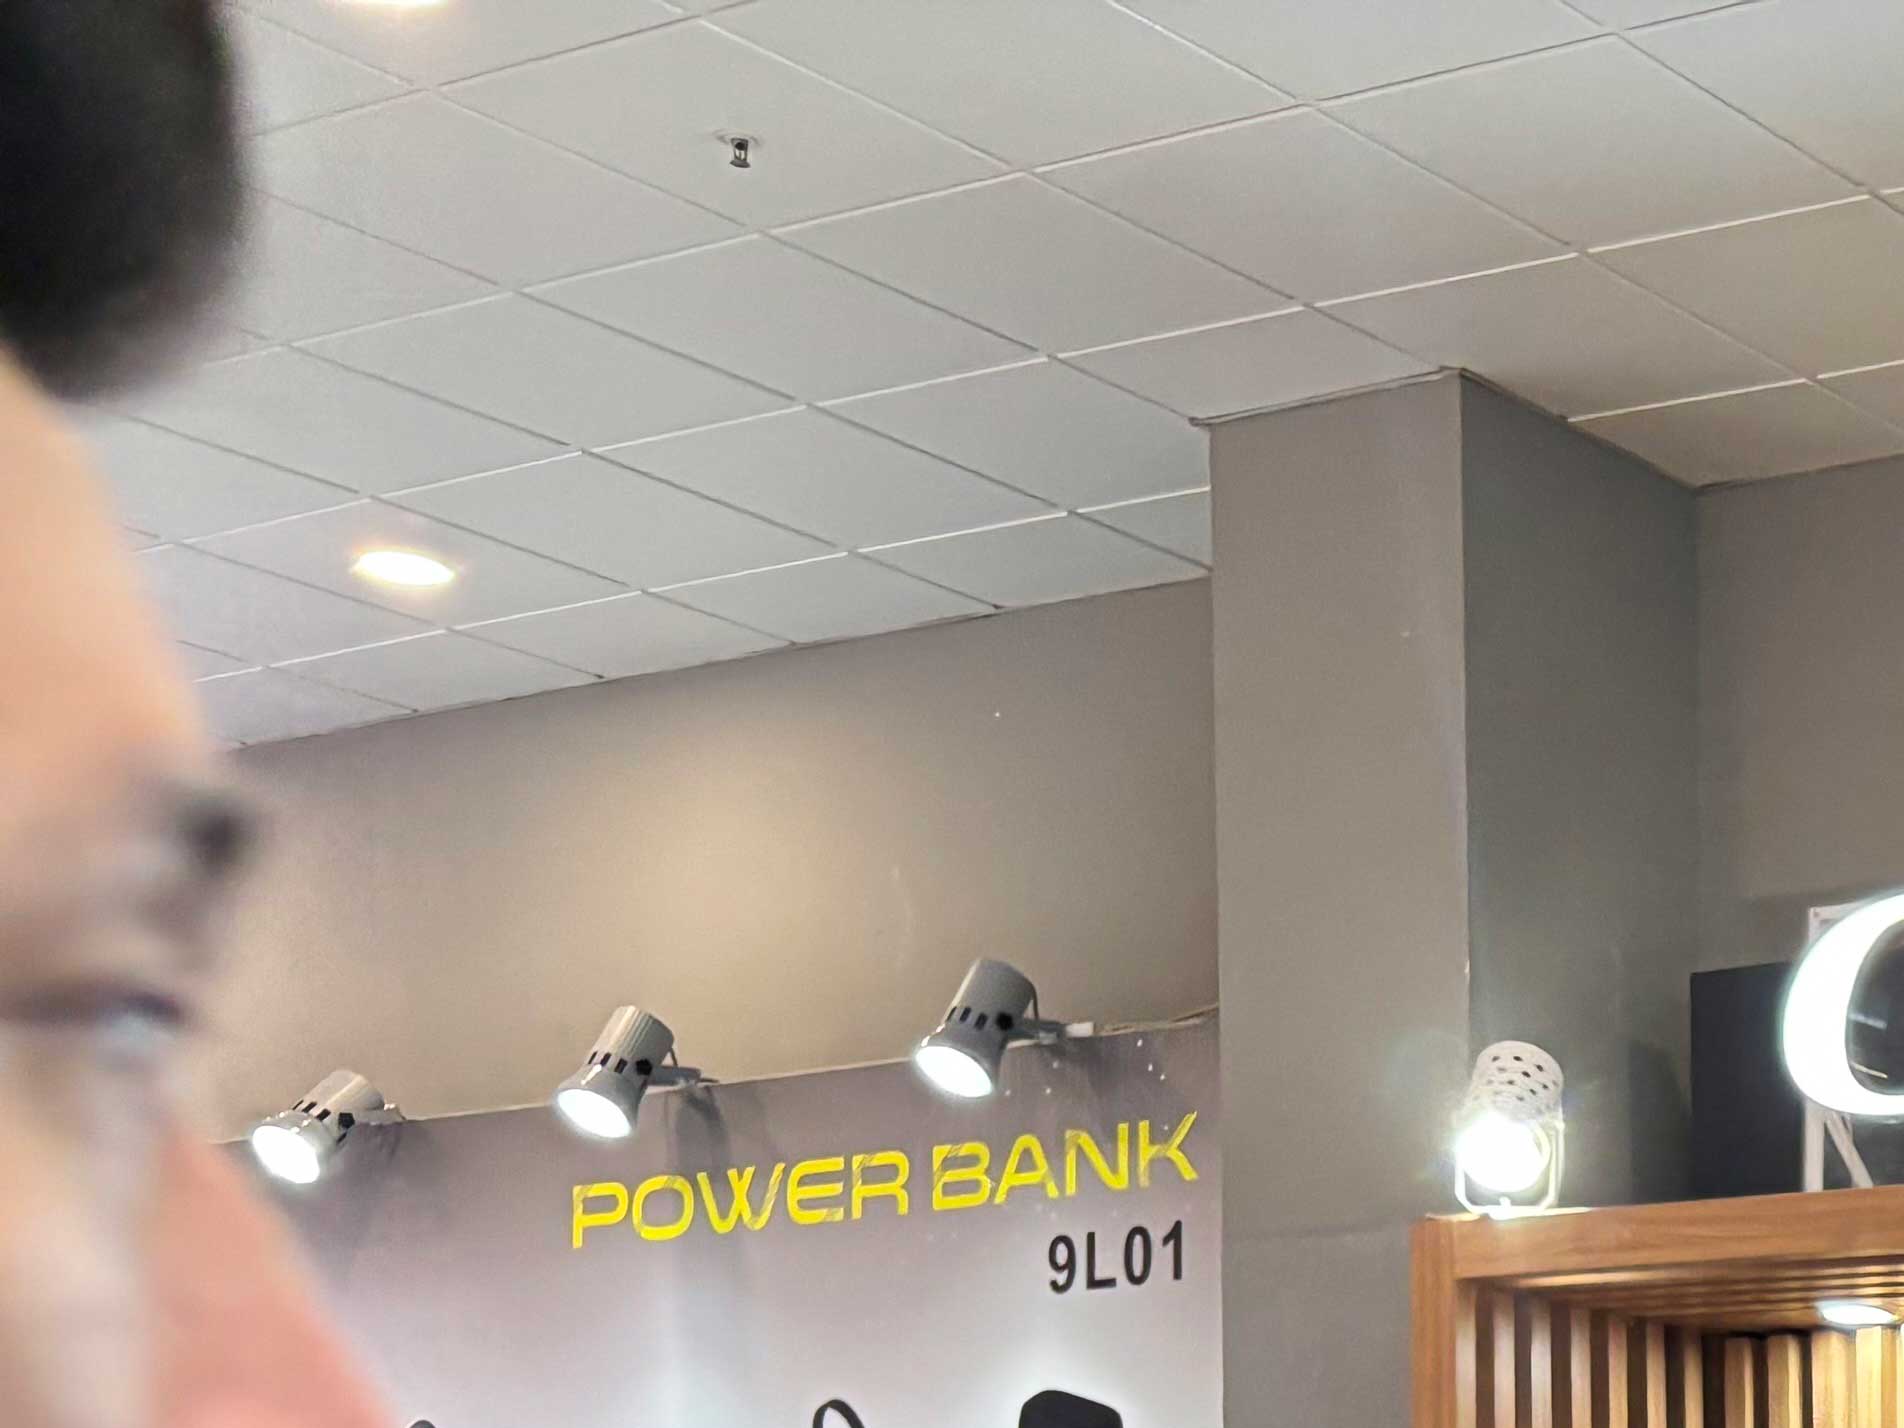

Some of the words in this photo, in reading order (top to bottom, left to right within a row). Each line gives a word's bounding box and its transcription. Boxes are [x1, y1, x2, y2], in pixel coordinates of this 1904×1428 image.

[571, 1149, 909, 1249] POWER
[931, 1109, 1198, 1211] BANK
[1047, 1219, 1186, 1295] 9L01
